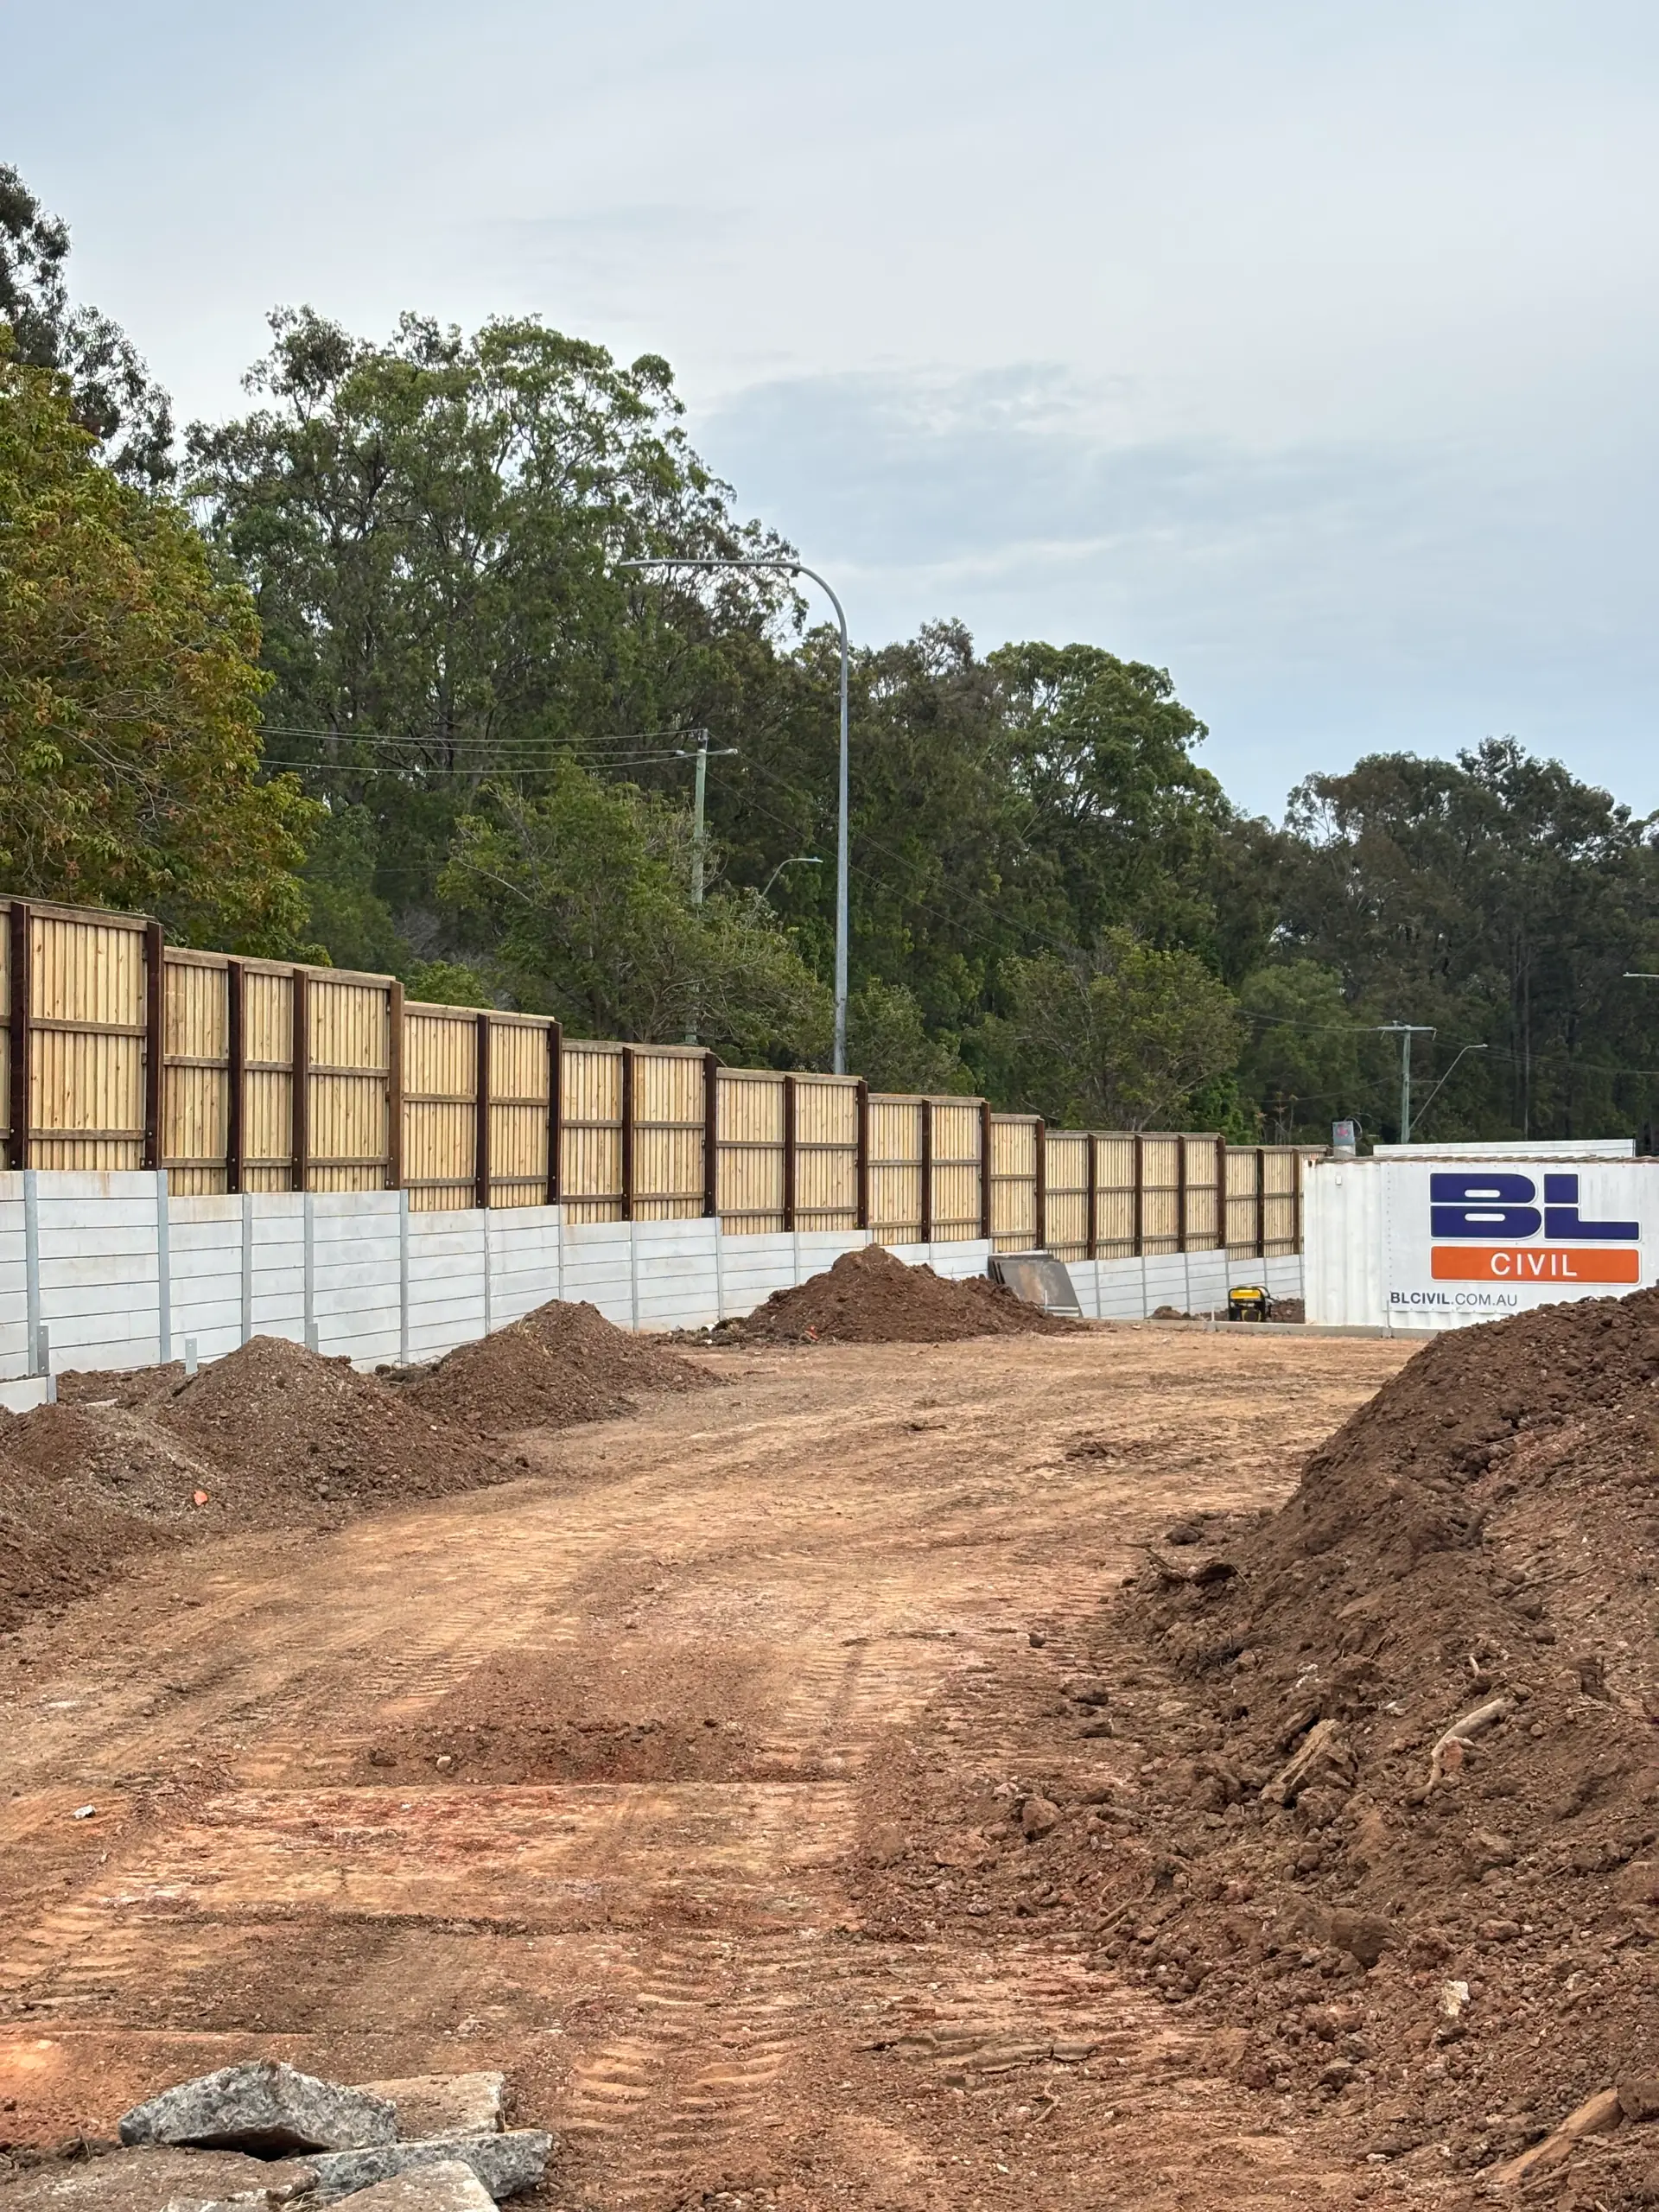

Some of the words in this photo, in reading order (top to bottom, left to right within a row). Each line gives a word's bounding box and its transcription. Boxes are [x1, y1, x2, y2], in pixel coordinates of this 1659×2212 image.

[1430, 1173, 1639, 1240] BL
[1491, 1253, 1578, 1277] CIVIL
[1390, 1292, 1518, 1306] BLCIVIL.COM.AU
